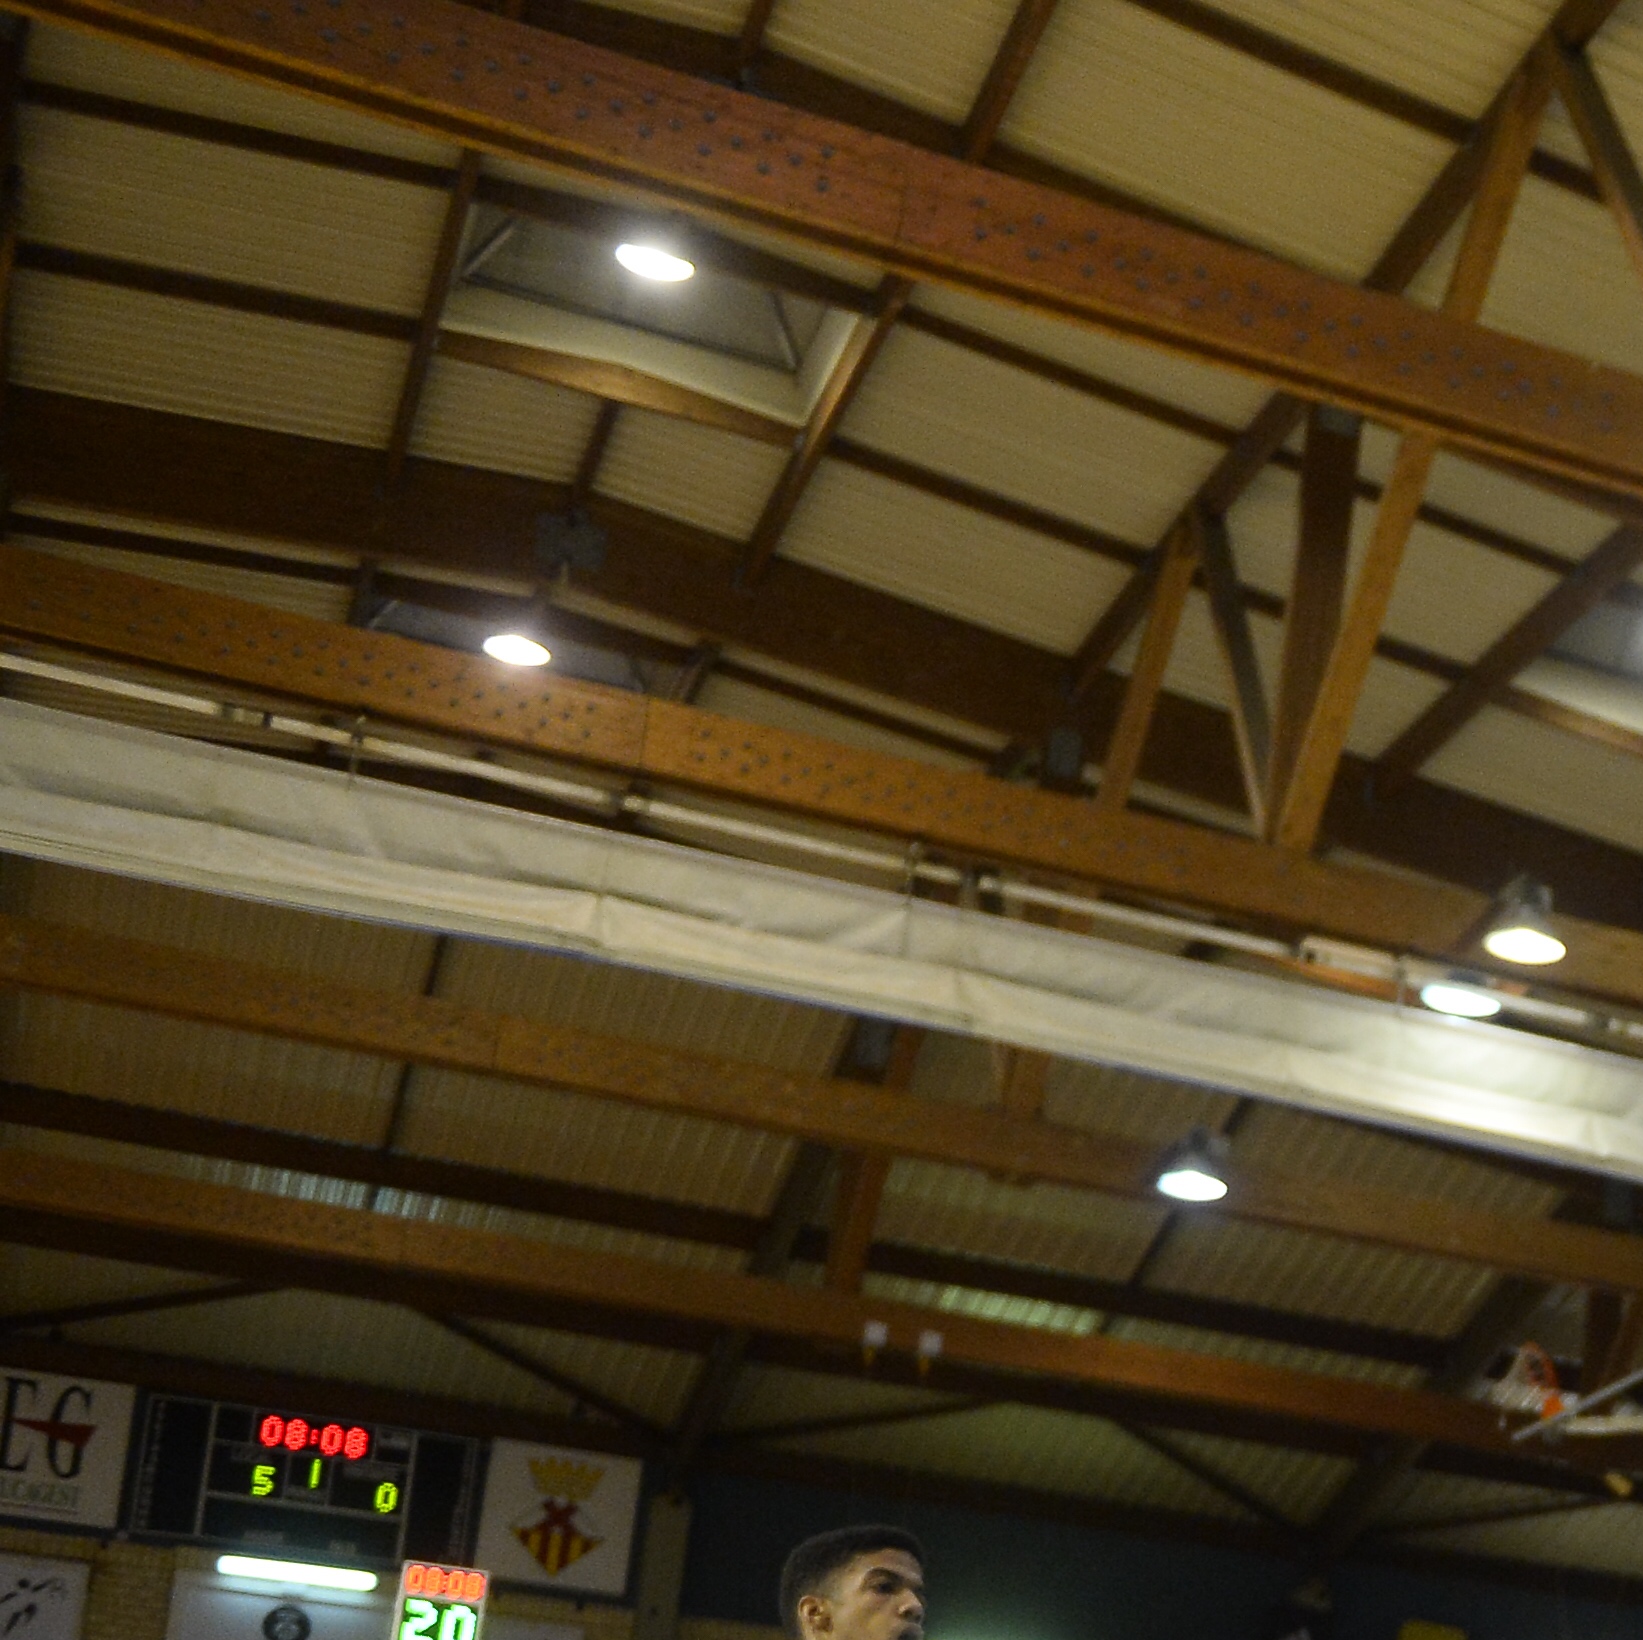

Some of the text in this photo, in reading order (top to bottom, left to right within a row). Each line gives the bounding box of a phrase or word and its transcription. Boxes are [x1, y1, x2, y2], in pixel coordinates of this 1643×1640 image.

[259, 1415, 369, 1460] 08:08
[251, 1465, 276, 1496] 5
[308, 1458, 322, 1489] 1
[374, 1482, 398, 1513] 0
[404, 1564, 486, 1602] 08:08
